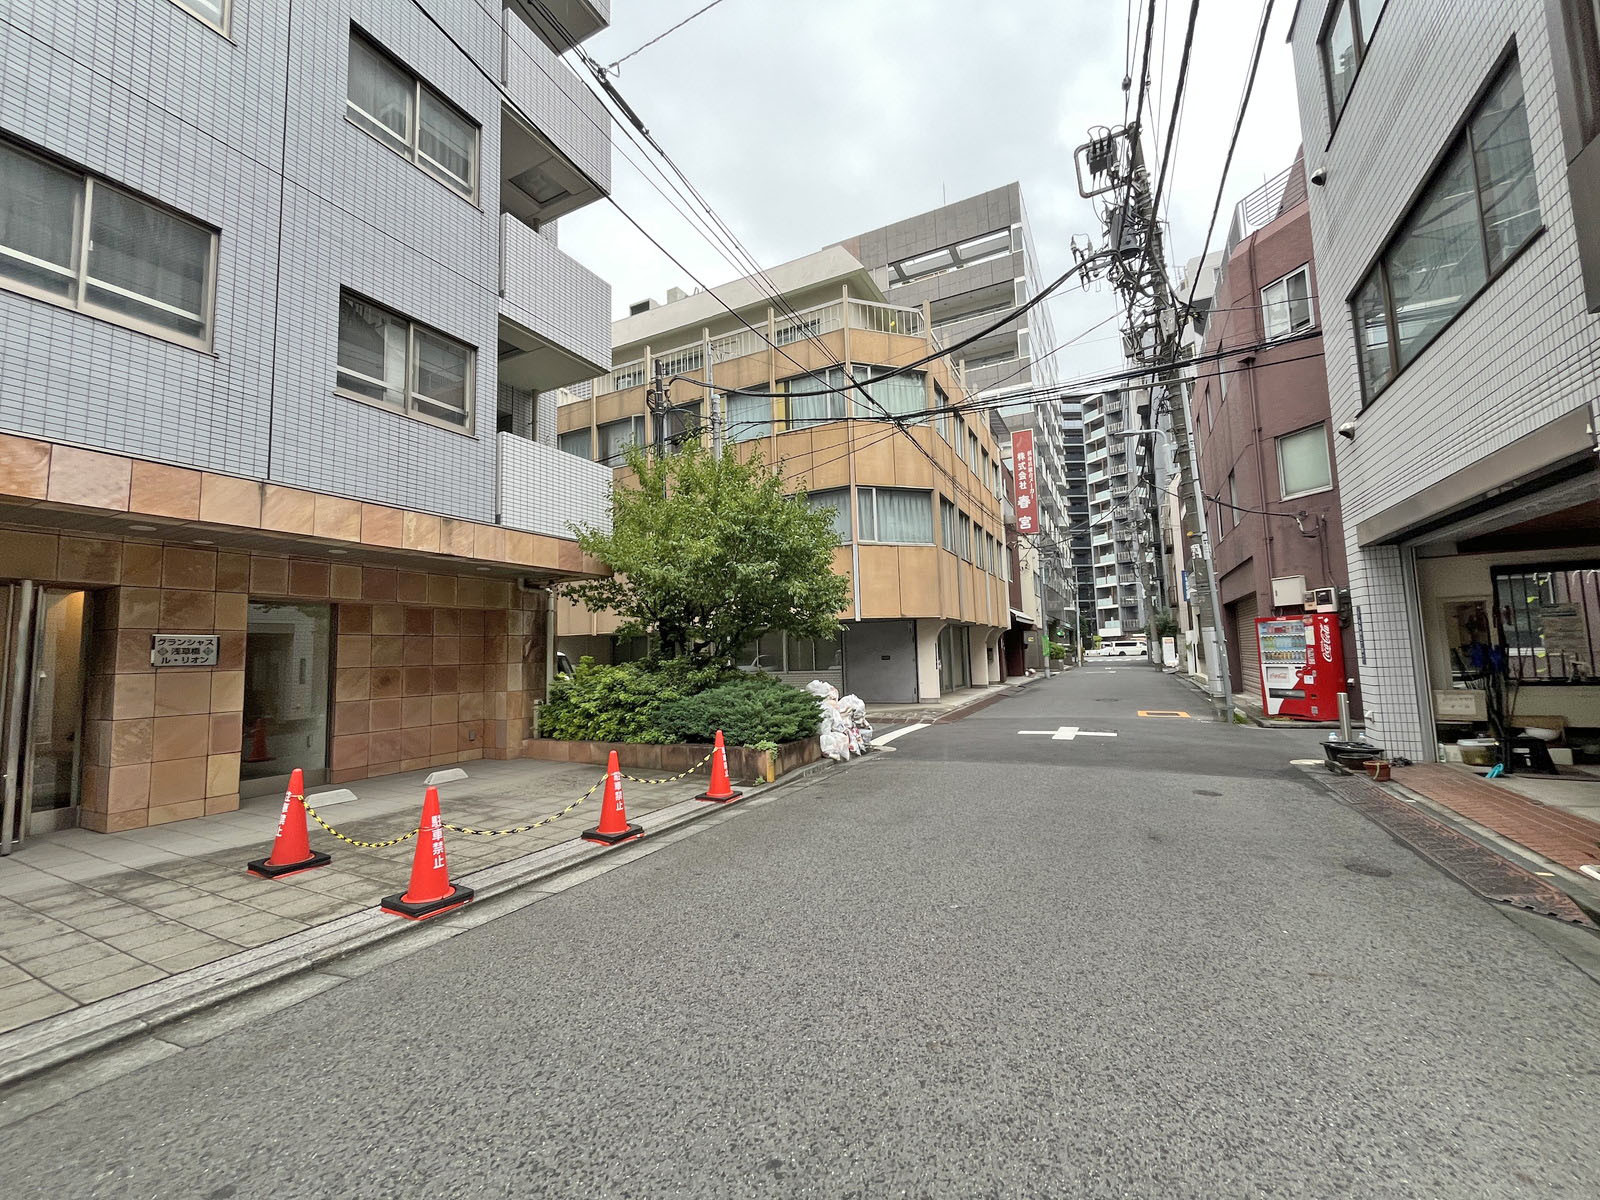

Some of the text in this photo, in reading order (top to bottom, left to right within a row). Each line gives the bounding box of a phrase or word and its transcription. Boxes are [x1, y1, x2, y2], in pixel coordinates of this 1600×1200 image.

[1017, 452, 1027, 490] 株式会社
[431, 815, 445, 869] 駐車禁止
